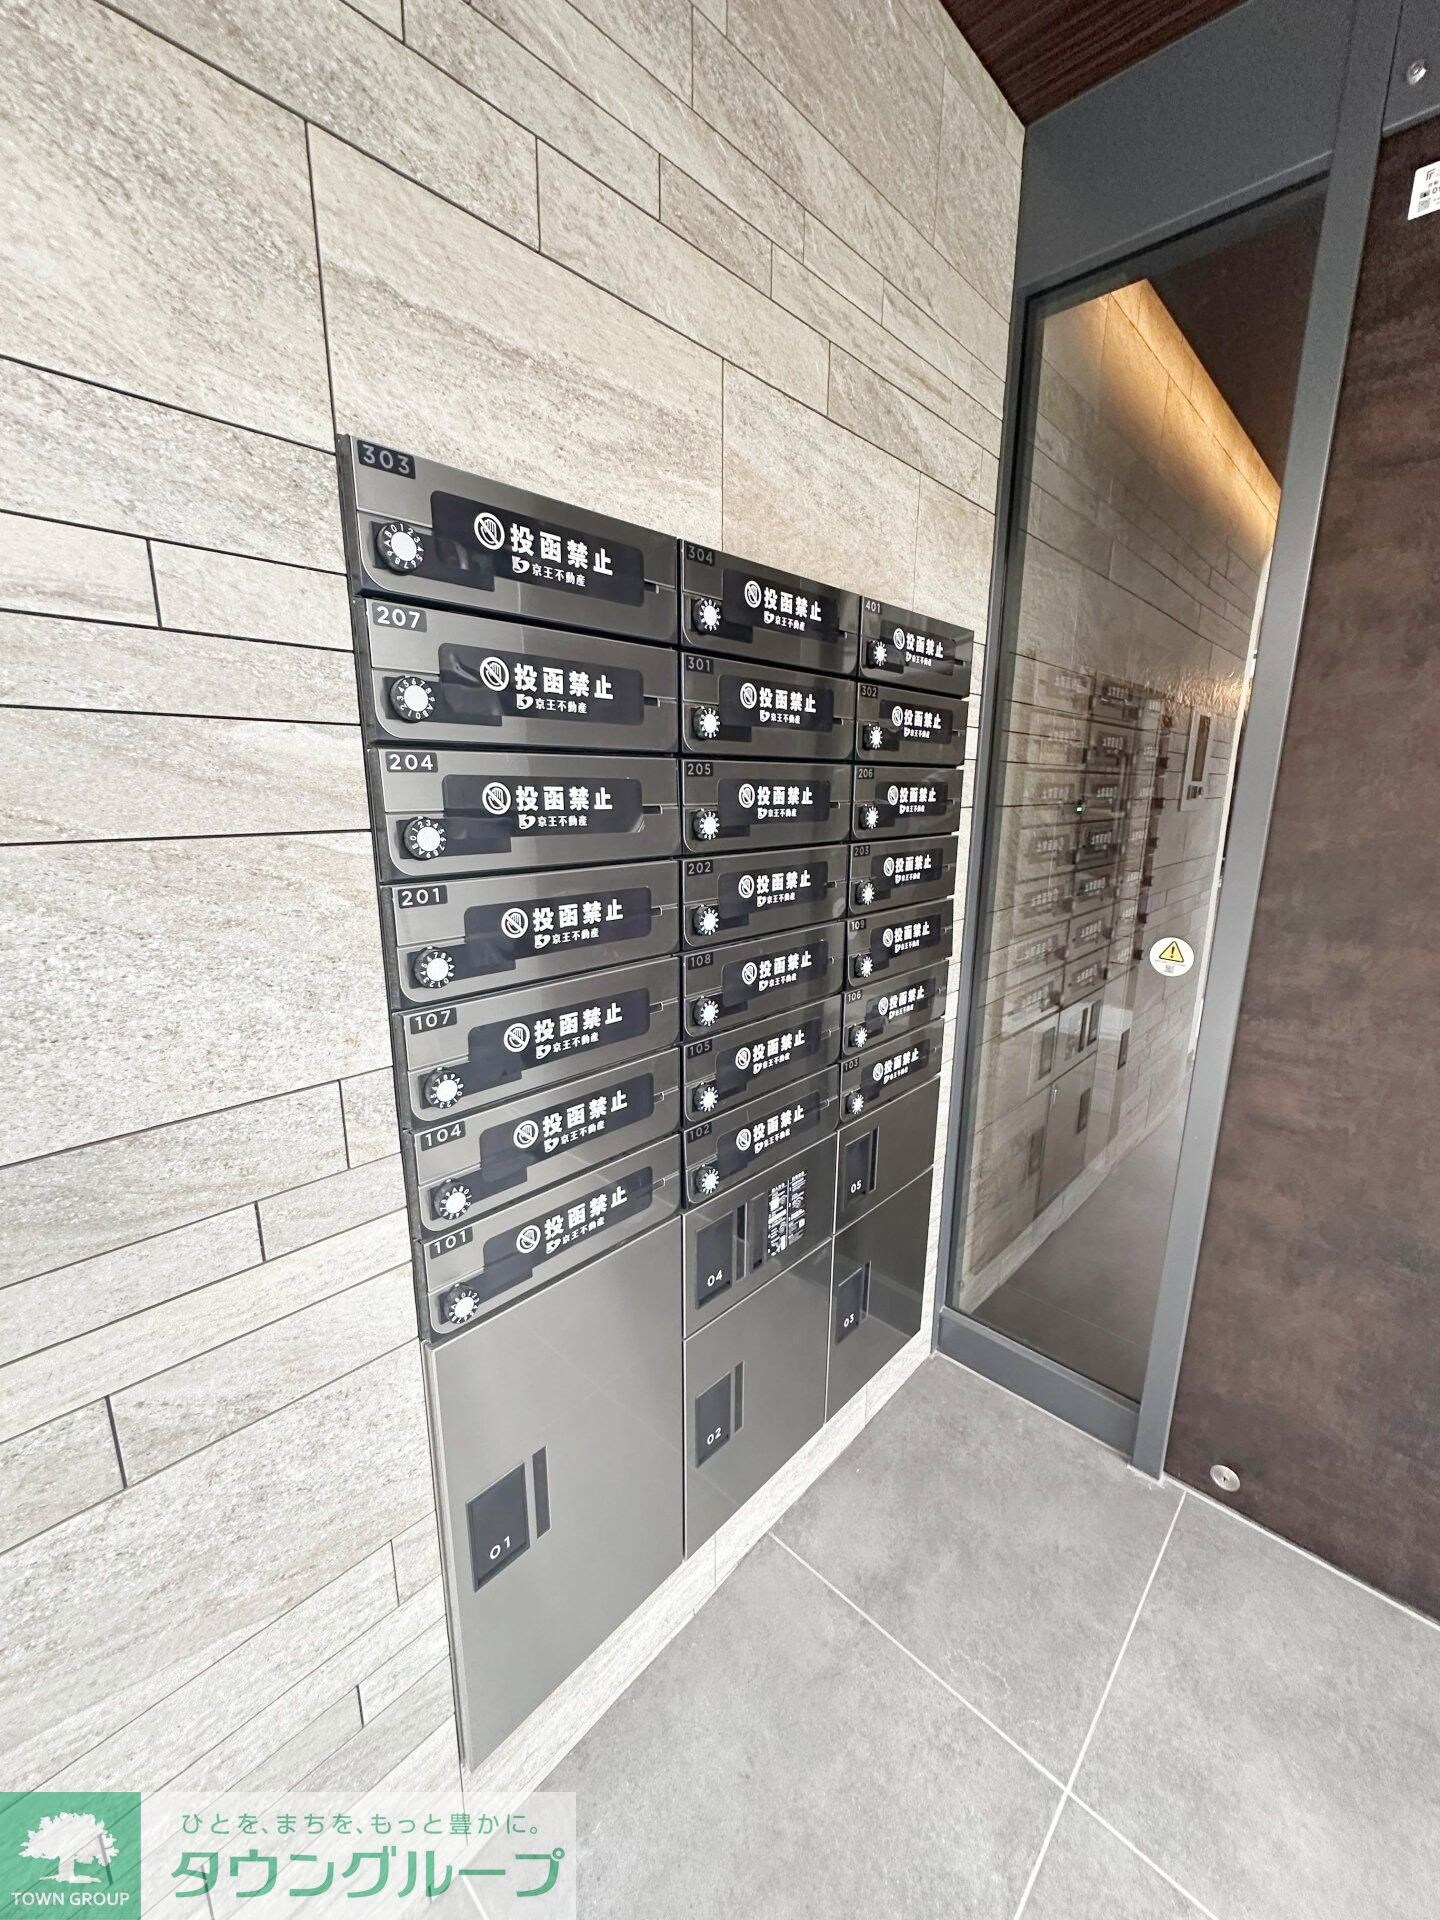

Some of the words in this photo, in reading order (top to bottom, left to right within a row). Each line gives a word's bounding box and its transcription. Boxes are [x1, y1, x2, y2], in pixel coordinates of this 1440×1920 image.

[362, 443, 410, 475] 303
[510, 523, 614, 576] 投函禁止
[688, 549, 713, 565] 304
[532, 563, 586, 587] 京王不動産
[764, 587, 822, 622] 投函禁止
[866, 600, 881, 613] 401
[376, 605, 421, 629] 207
[688, 658, 711, 671] 301
[514, 663, 614, 700] 投函禁止
[759, 687, 817, 713] 投函禁止
[861, 686, 877, 697] 302
[535, 697, 588, 714] 京王不動産
[389, 754, 434, 771] 204
[687, 764, 711, 775] 205
[858, 768, 873, 778] 206
[515, 785, 613, 811] 投函禁止
[757, 786, 813, 806] 投函禁止
[537, 814, 588, 827] 京王不動産
[854, 846, 869, 856] 203
[687, 862, 711, 874] 202
[756, 870, 811, 894] 投函禁止
[401, 888, 440, 906] 201
[532, 899, 624, 932] 投函禁止
[851, 920, 865, 930] 109
[552, 928, 600, 944] 京王不動産
[690, 955, 711, 968] 108
[759, 951, 812, 979] 投函禁止
[847, 991, 861, 1001] 106
[414, 1011, 451, 1031] 107
[533, 1003, 623, 1043] 投函禁止
[553, 1032, 600, 1053] 京王不動産
[689, 1041, 710, 1055] 105
[752, 1030, 805, 1063] 投函禁止
[844, 1059, 859, 1070] 103
[542, 1090, 628, 1137] 投函禁止
[689, 1124, 710, 1139] 102
[753, 1105, 805, 1143] 投函禁止
[425, 1124, 462, 1147] 104
[850, 1180, 862, 1193] 05
[544, 1186, 628, 1240] 投函禁止
[434, 1230, 467, 1255] 101
[707, 1270, 723, 1287] 04
[843, 1313, 854, 1328] 03
[706, 1427, 722, 1445] 02
[489, 1536, 511, 1559] 01
